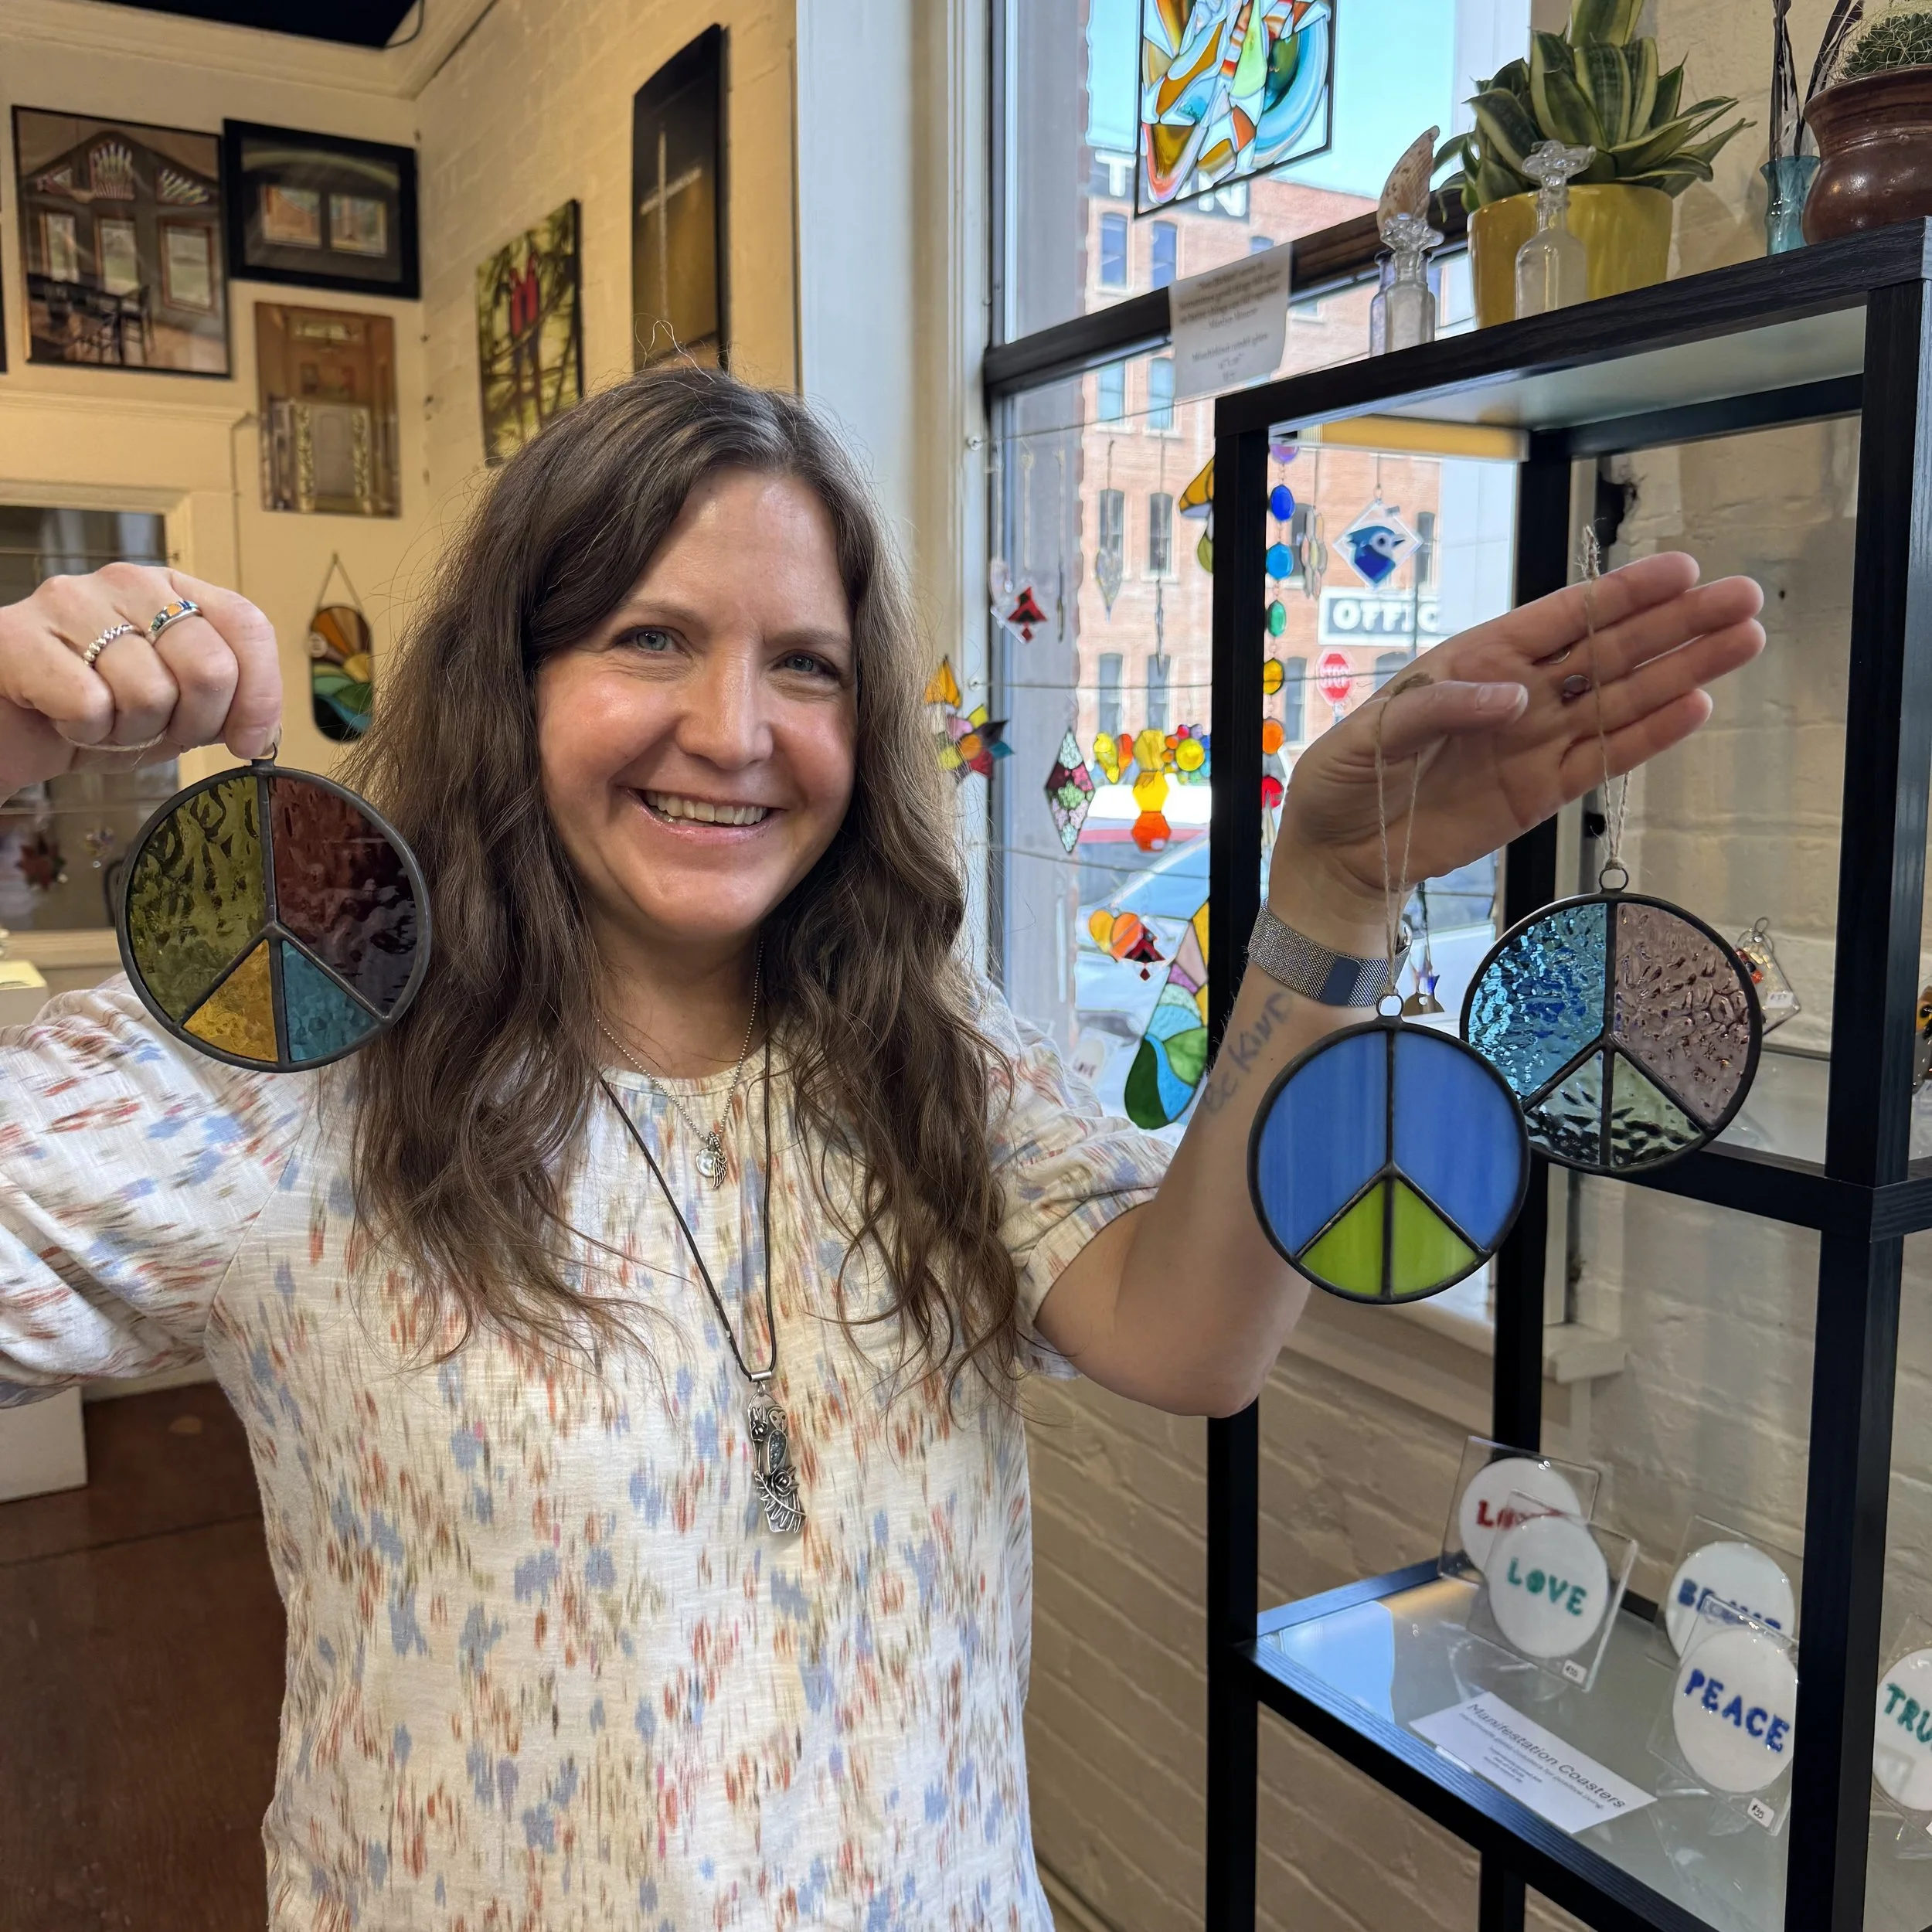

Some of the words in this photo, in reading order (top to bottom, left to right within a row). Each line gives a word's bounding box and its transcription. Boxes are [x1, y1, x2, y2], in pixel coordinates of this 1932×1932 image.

[1507, 1556, 1587, 1617] LOVE
[1683, 1668, 1791, 1753] PEACE
[1884, 1682, 1932, 1753] TRU
[1467, 1703, 1559, 1766] Manifestation
[1558, 1764, 1626, 1808] Coasters
